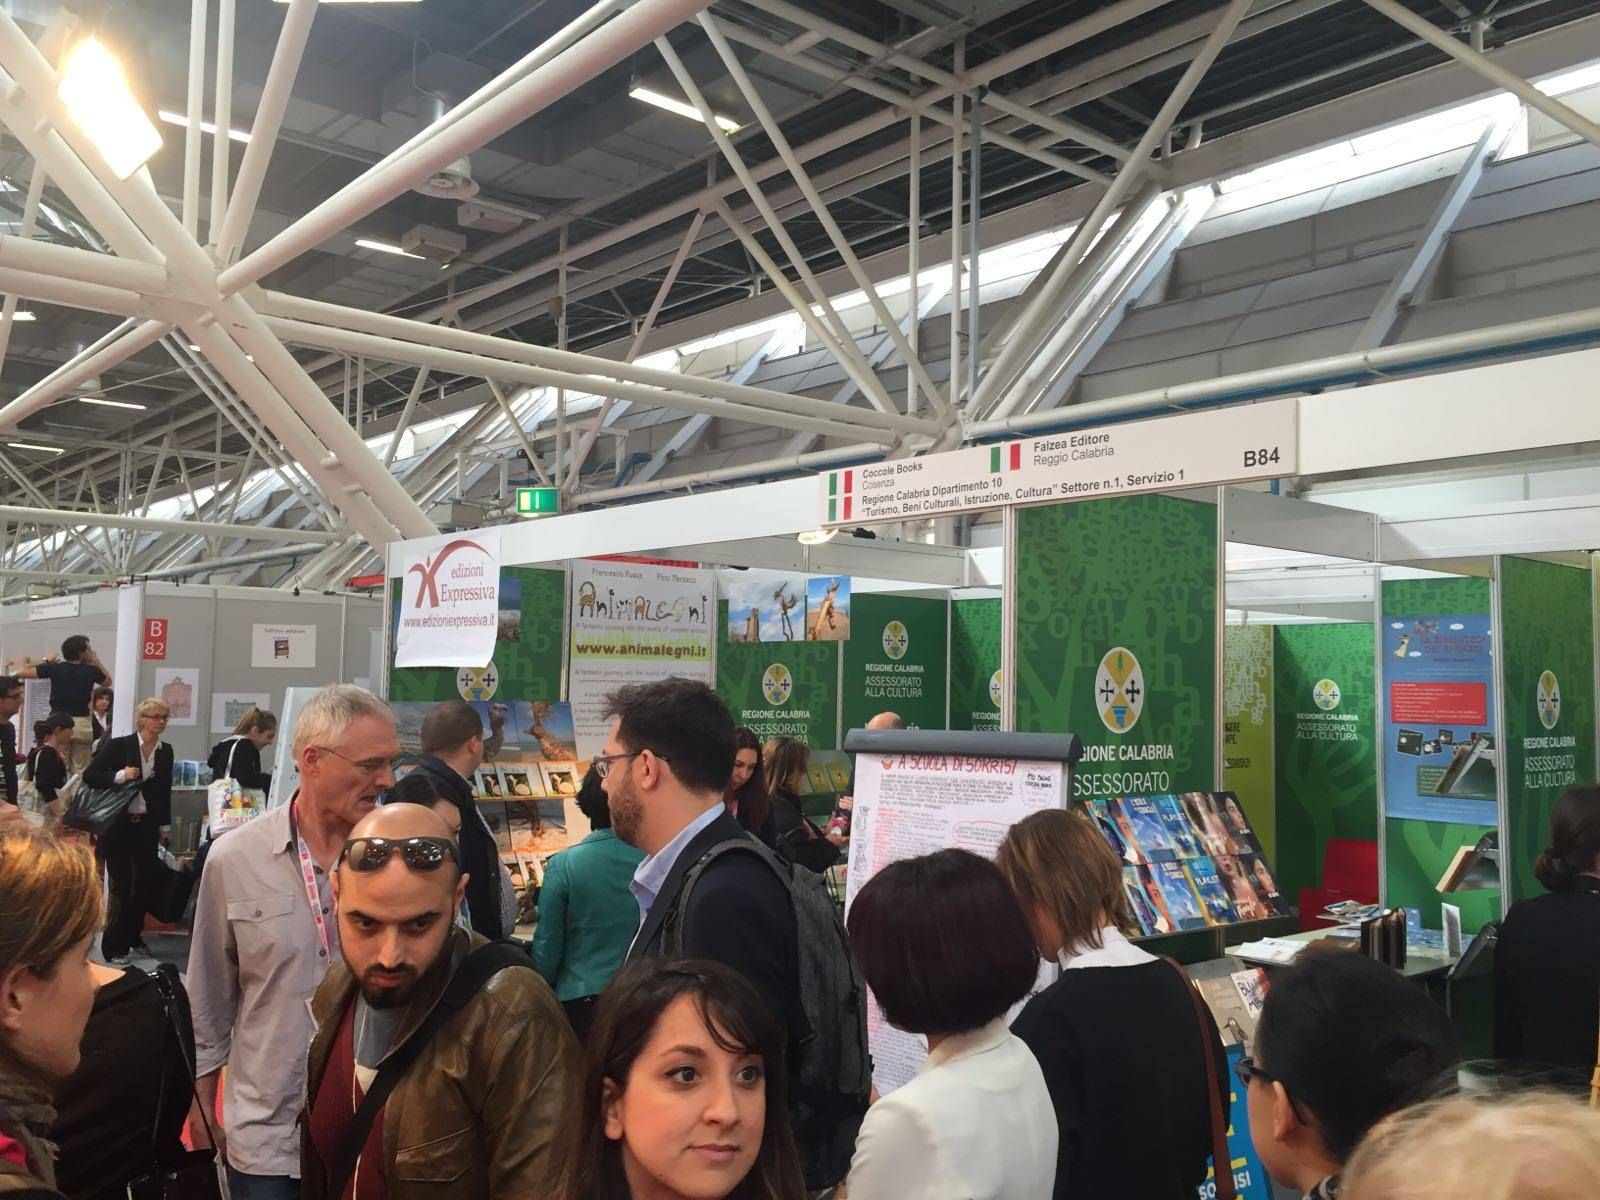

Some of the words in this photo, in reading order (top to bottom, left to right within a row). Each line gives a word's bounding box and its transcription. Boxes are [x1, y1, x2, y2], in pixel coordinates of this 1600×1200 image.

[1034, 439, 1067, 452] Falzea
[1071, 434, 1109, 447] Editore
[1034, 452, 1068, 467] Reggio
[1071, 446, 1114, 461] Calabria
[1244, 447, 1280, 467] B84
[863, 466, 895, 479] Coccole
[897, 462, 923, 474] Books
[862, 478, 895, 490] Cosenza
[862, 493, 894, 506] Regione
[897, 487, 929, 501] Calabria
[932, 480, 989, 496] Dipartimento
[992, 477, 1002, 488] 10
[903, 501, 921, 513] Beni
[923, 496, 962, 510] Culturali,
[964, 490, 1012, 505] Istruzione,
[1061, 480, 1100, 494] Settore
[1104, 477, 1123, 489] n.1,
[1127, 470, 1175, 486] Servizio
[1178, 469, 1184, 480] 1
[451, 562, 484, 579] edizioni
[441, 582, 495, 608] Expressiva
[150, 621, 162, 637] B
[404, 613, 495, 630] www.edizioniexpressiva.it
[144, 641, 165, 656] 82
[576, 644, 706, 659] www.animalegni.it
[865, 663, 893, 672] REGIONE
[894, 664, 924, 673] CALABRIA
[864, 675, 922, 687] ASSESSORATO
[864, 687, 885, 697] ALLA
[886, 687, 922, 698] CULTURA
[742, 710, 774, 719] REGIONE
[775, 710, 811, 719] CALABRIA
[972, 711, 1001, 721] REGIONE
[1326, 713, 1359, 721] CALABRIA
[744, 723, 808, 735] SSESSORATO
[1296, 722, 1357, 733] ASSESSORATO
[1296, 731, 1317, 739] ALLA
[1320, 731, 1358, 741] CULTURA
[1523, 736, 1549, 749] REGIONE
[1549, 736, 1576, 748] CALABRIA
[1079, 745, 1116, 762] GIONE
[1119, 744, 1174, 761] CALABRIA
[898, 756, 906, 770] A
[910, 755, 948, 772] SCUOLA
[952, 757, 963, 772] DI
[1524, 754, 1575, 772] ASSESSORATO
[1074, 771, 1170, 796] SSESSORATO
[1524, 773, 1543, 789] ALLA
[1544, 770, 1576, 788] CULTURA
[1198, 1170, 1252, 1200] SOISI
